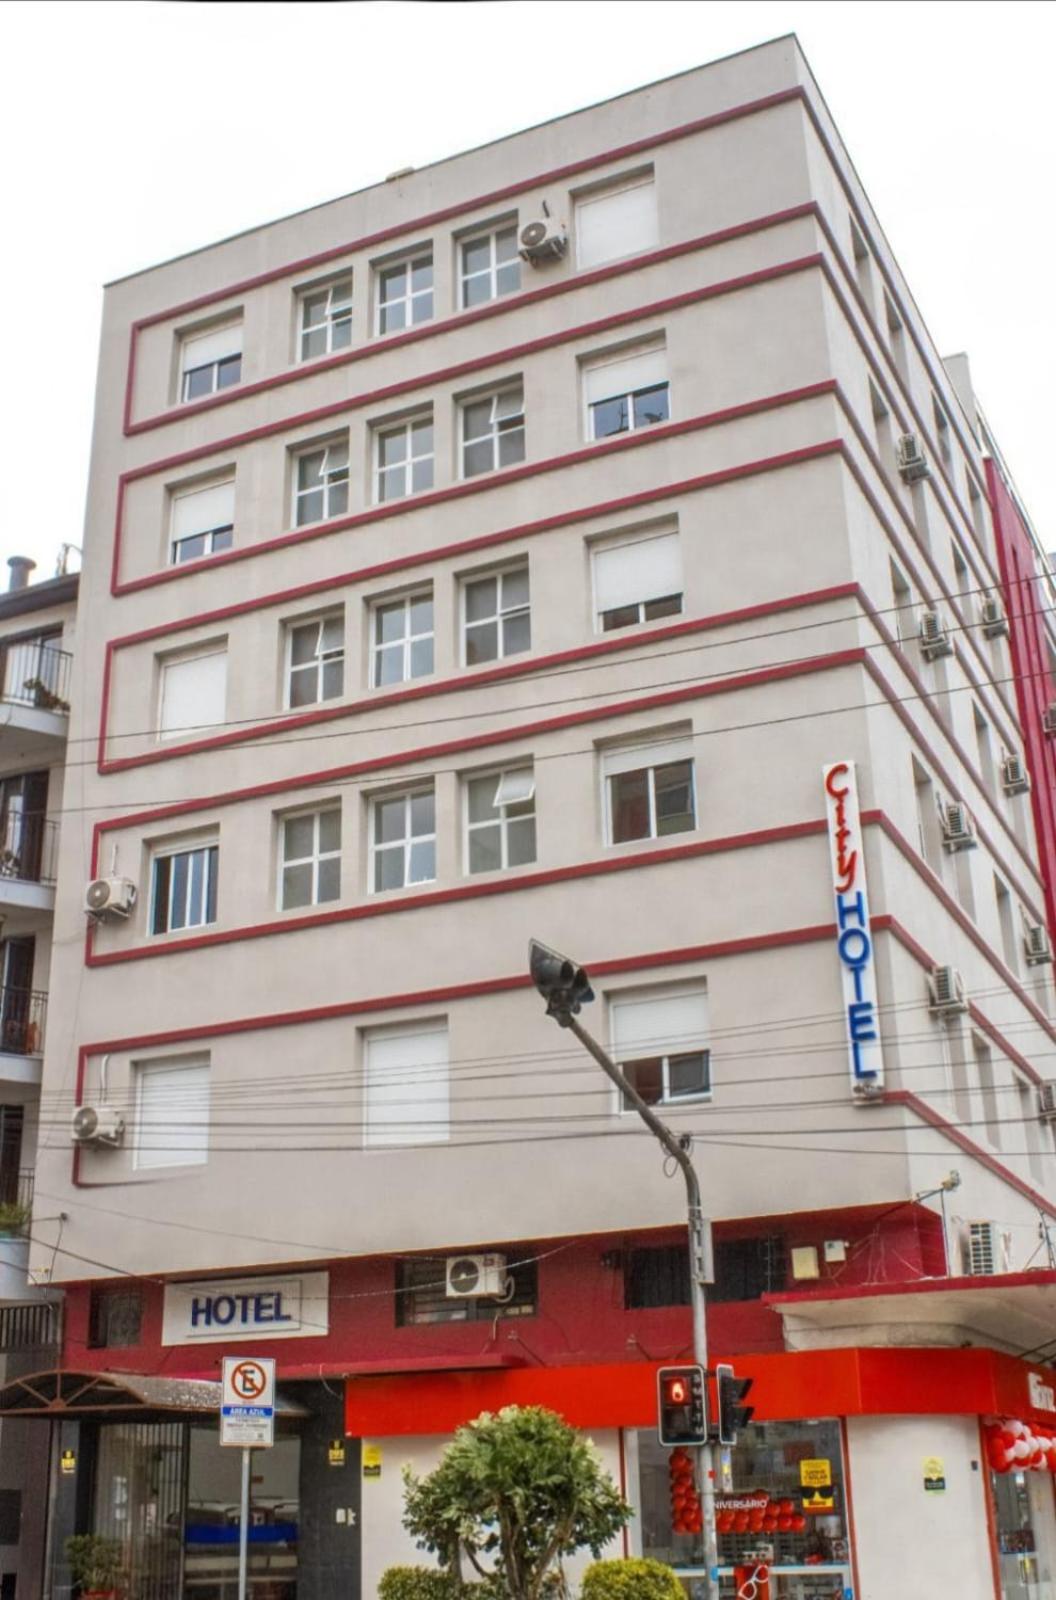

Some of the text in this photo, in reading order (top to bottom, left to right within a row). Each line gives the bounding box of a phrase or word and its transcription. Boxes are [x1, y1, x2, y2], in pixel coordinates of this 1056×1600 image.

[837, 891, 877, 1079] HOTEL
[191, 1292, 292, 1327] HOTEL
[242, 1369, 255, 1392] E
